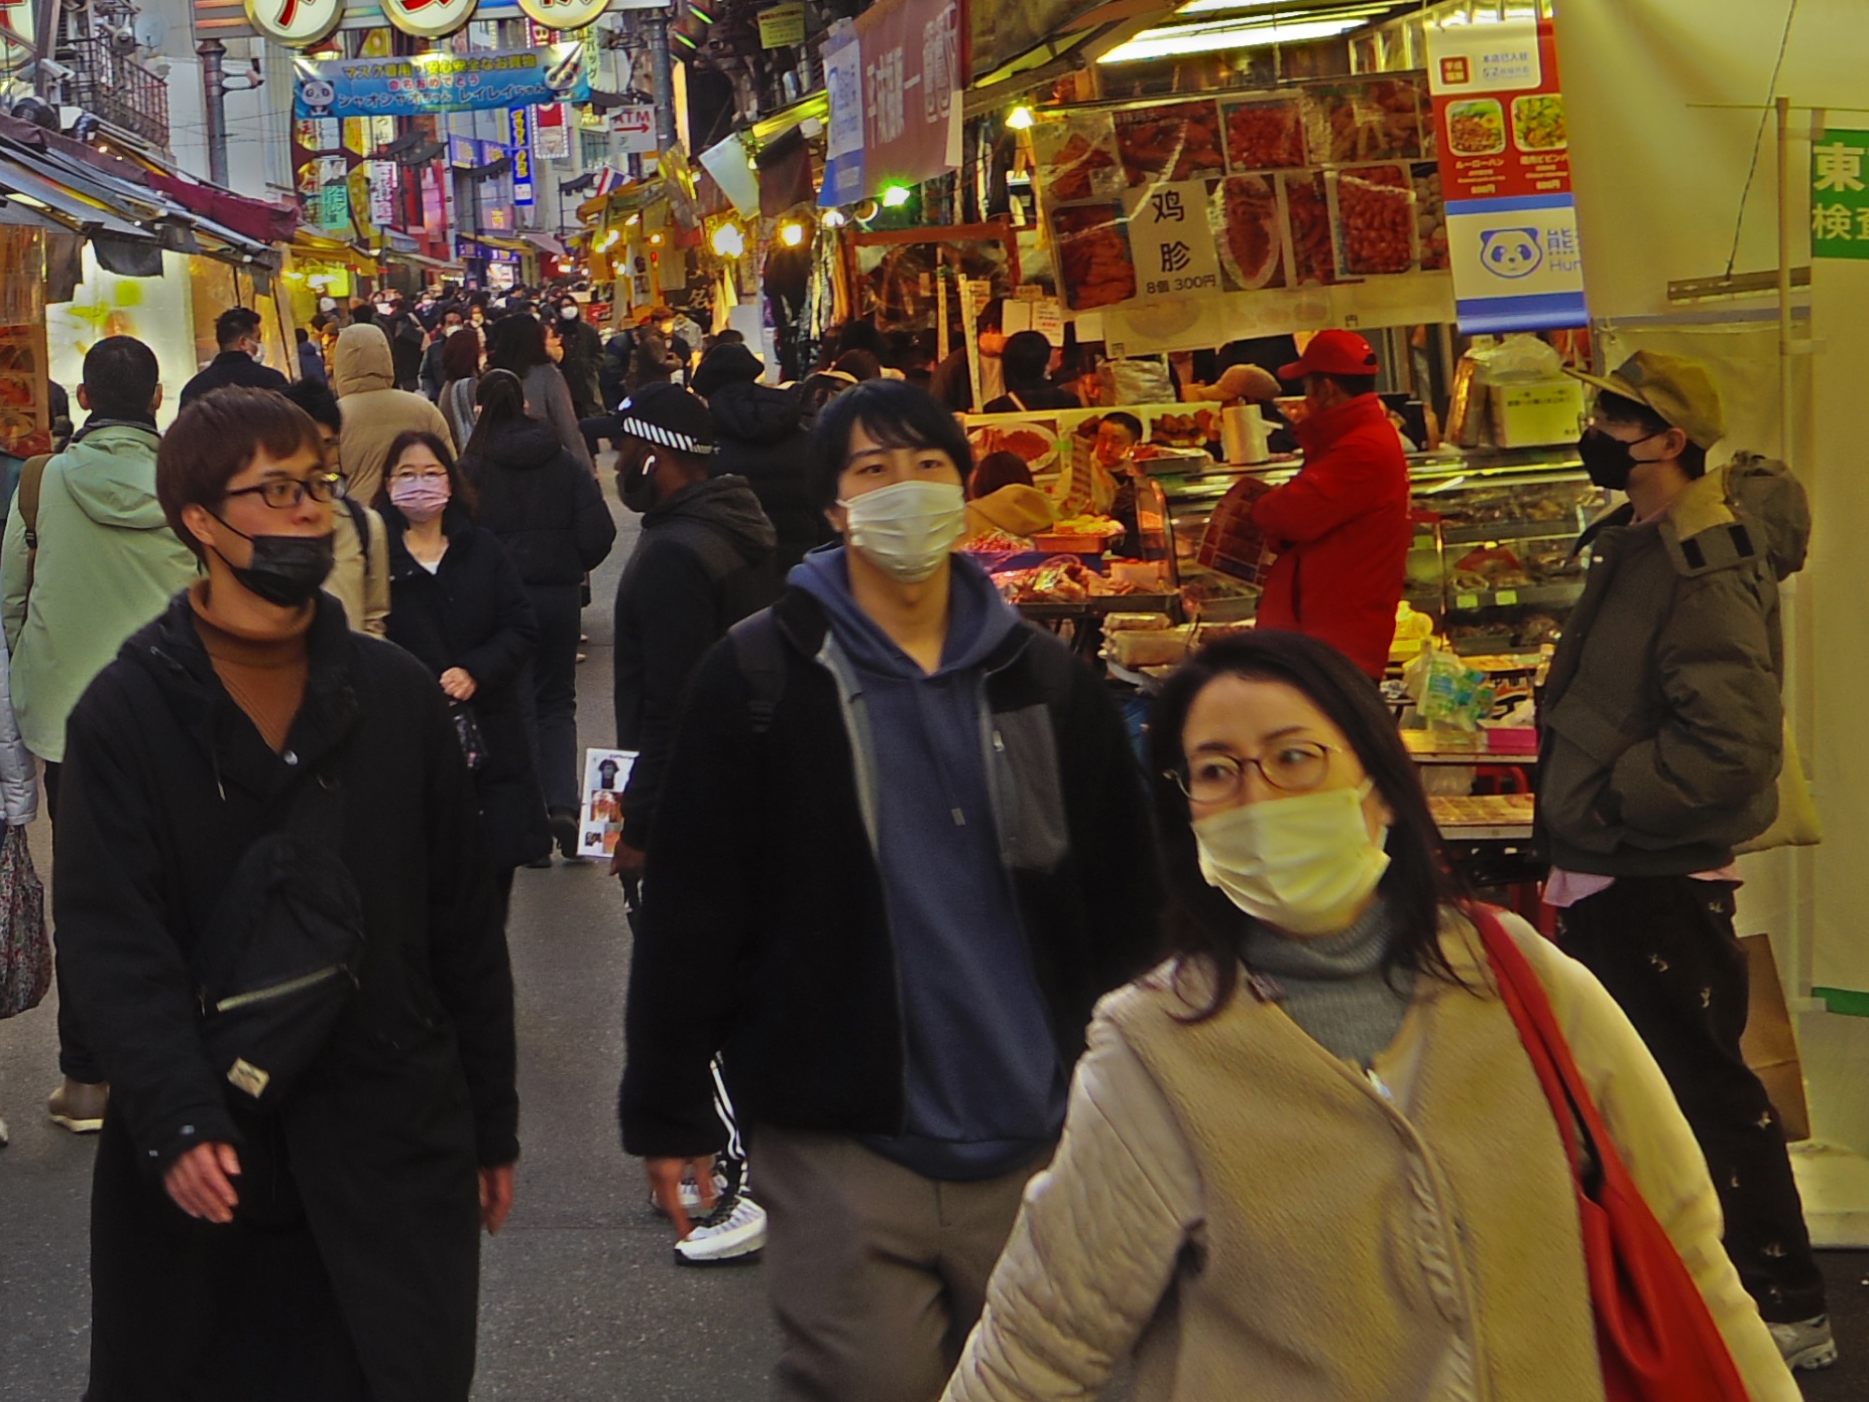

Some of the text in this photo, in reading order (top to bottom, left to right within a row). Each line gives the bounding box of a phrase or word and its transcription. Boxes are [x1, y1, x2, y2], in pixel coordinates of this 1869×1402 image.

[614, 109, 651, 125] ATM
[1146, 273, 1217, 295] 8個 300円
